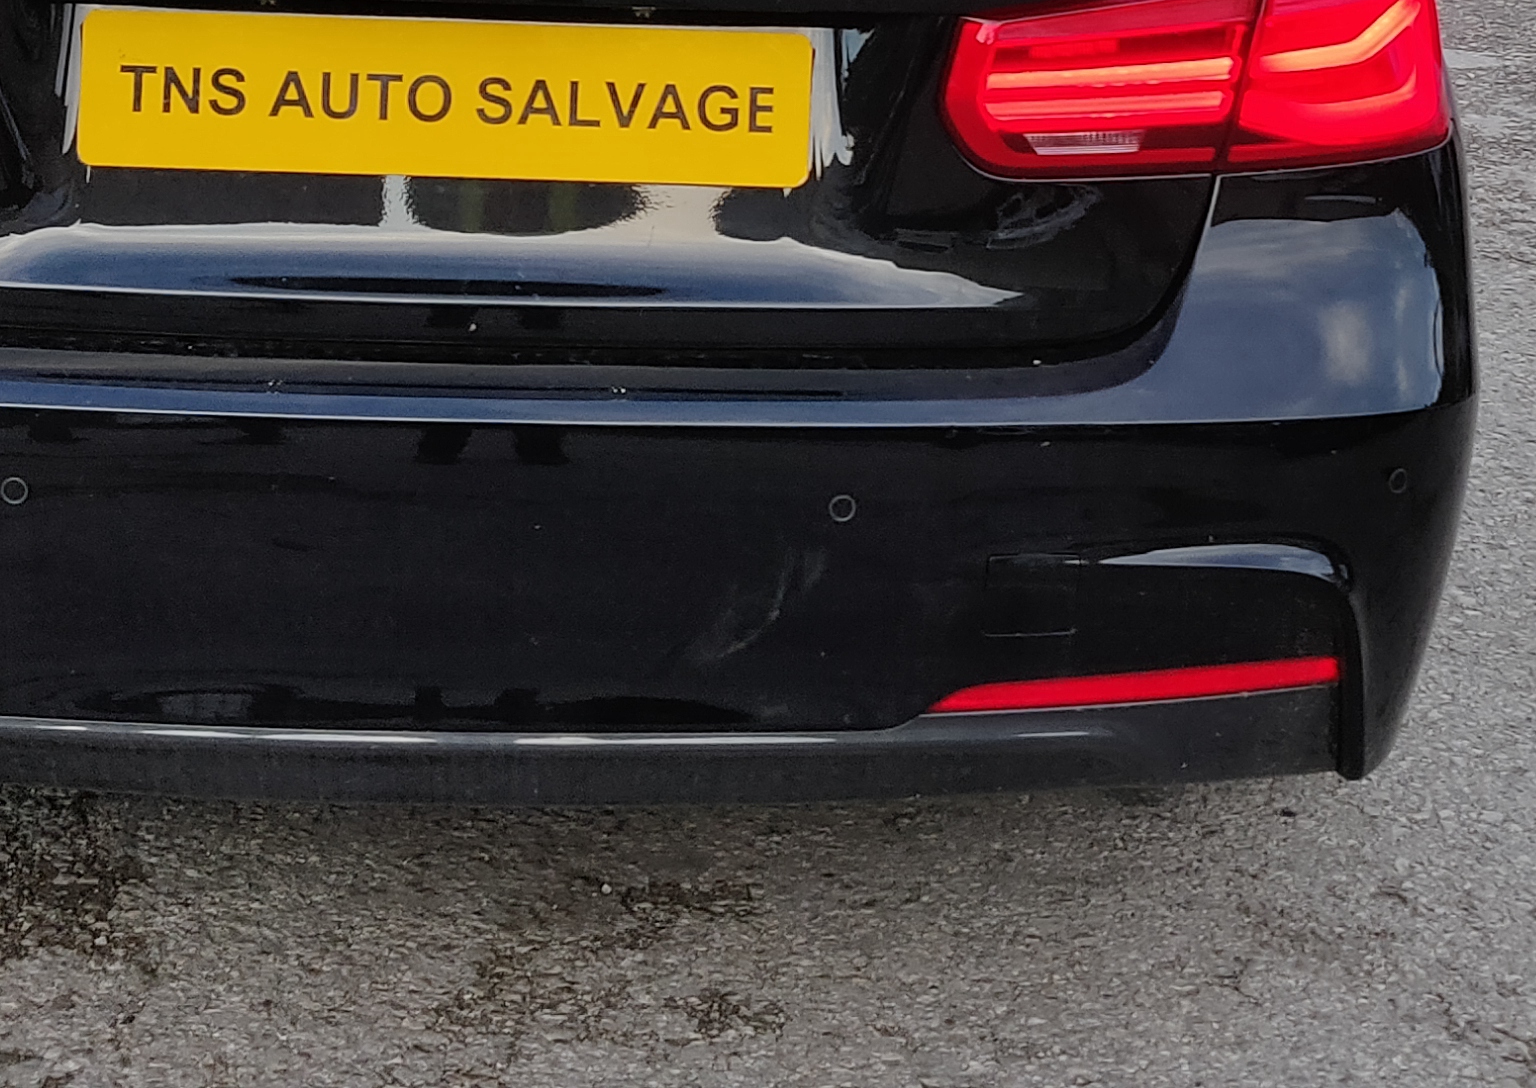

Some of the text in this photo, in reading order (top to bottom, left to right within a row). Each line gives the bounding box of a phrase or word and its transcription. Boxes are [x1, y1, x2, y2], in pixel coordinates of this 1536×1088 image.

[119, 63, 775, 134] TNS AUTO SALVAGE
